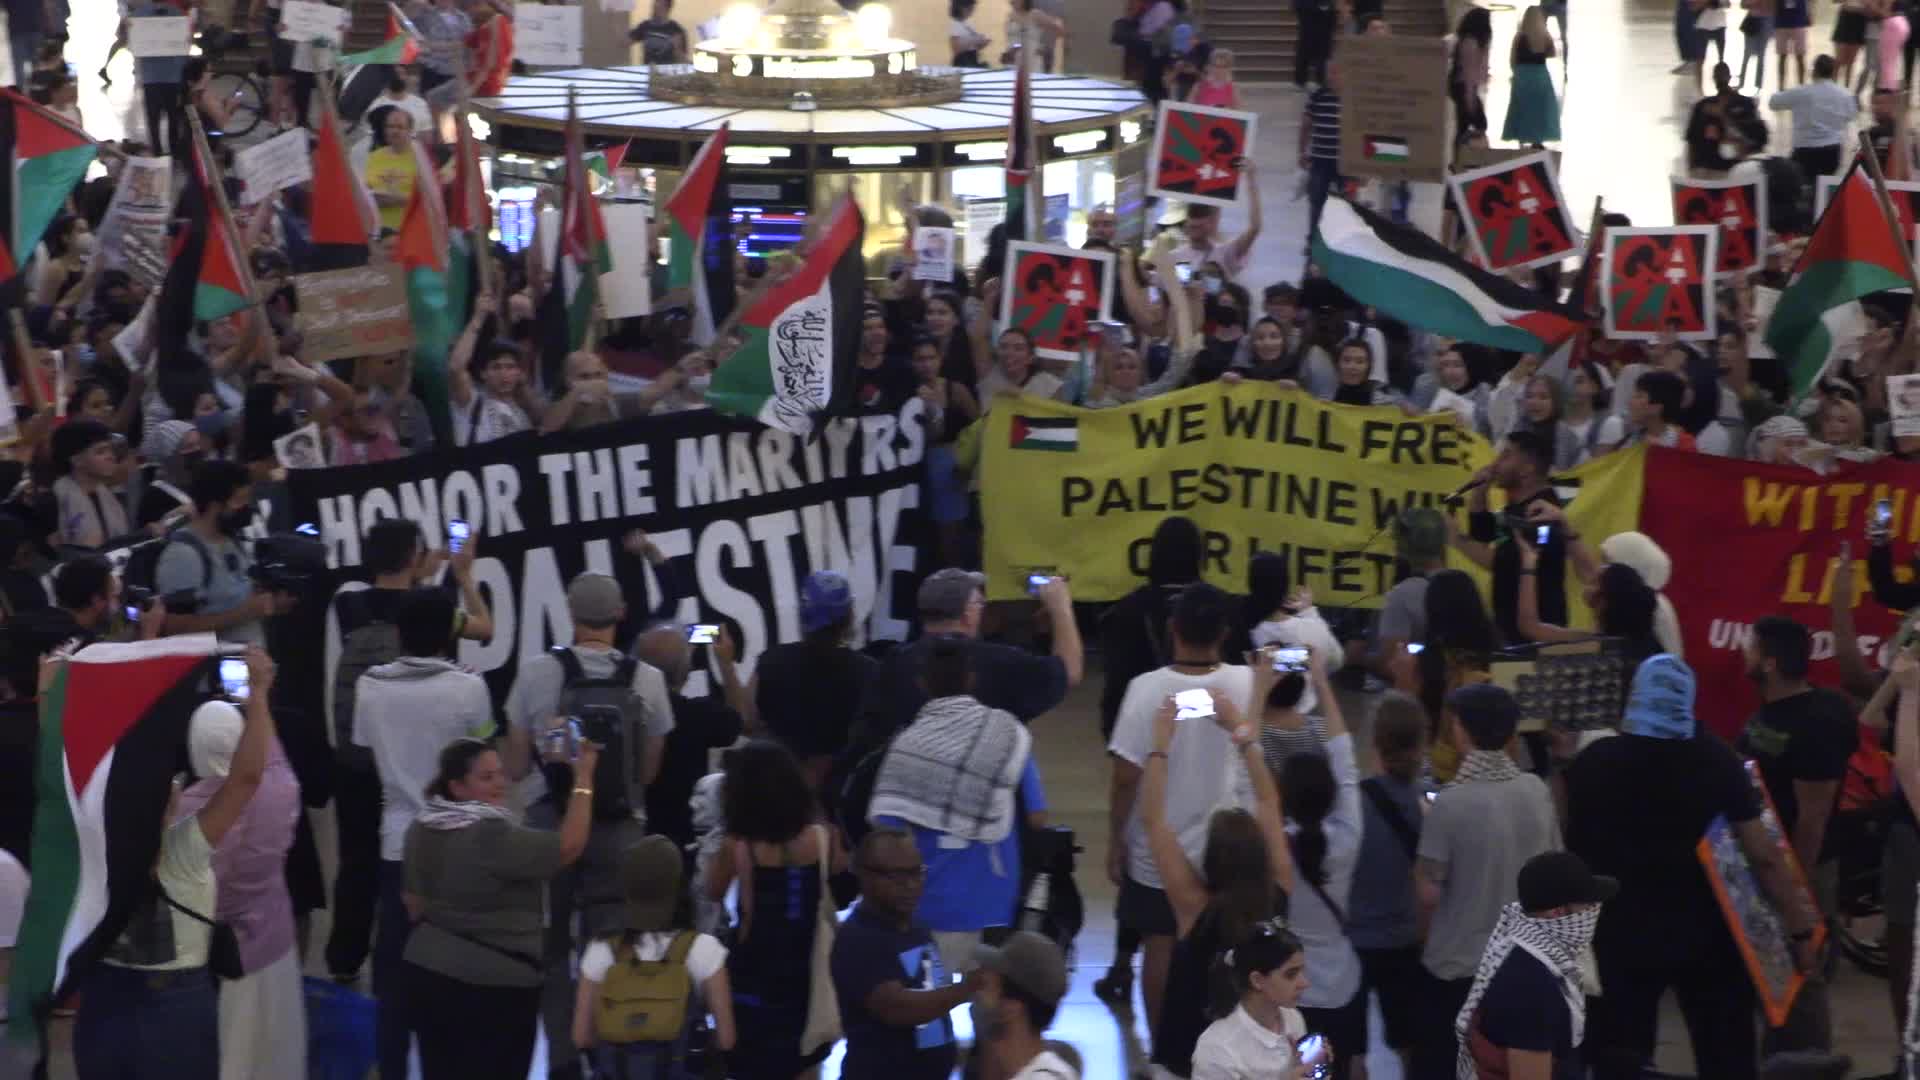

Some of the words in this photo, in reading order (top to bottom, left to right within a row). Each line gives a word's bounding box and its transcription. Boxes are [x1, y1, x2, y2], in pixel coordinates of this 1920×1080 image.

[1130, 404, 1207, 450] WE
[1221, 397, 1346, 453] WILL
[538, 443, 657, 526] THE
[1061, 463, 1358, 526] PALESTINE
[1127, 530, 1231, 577] OR
